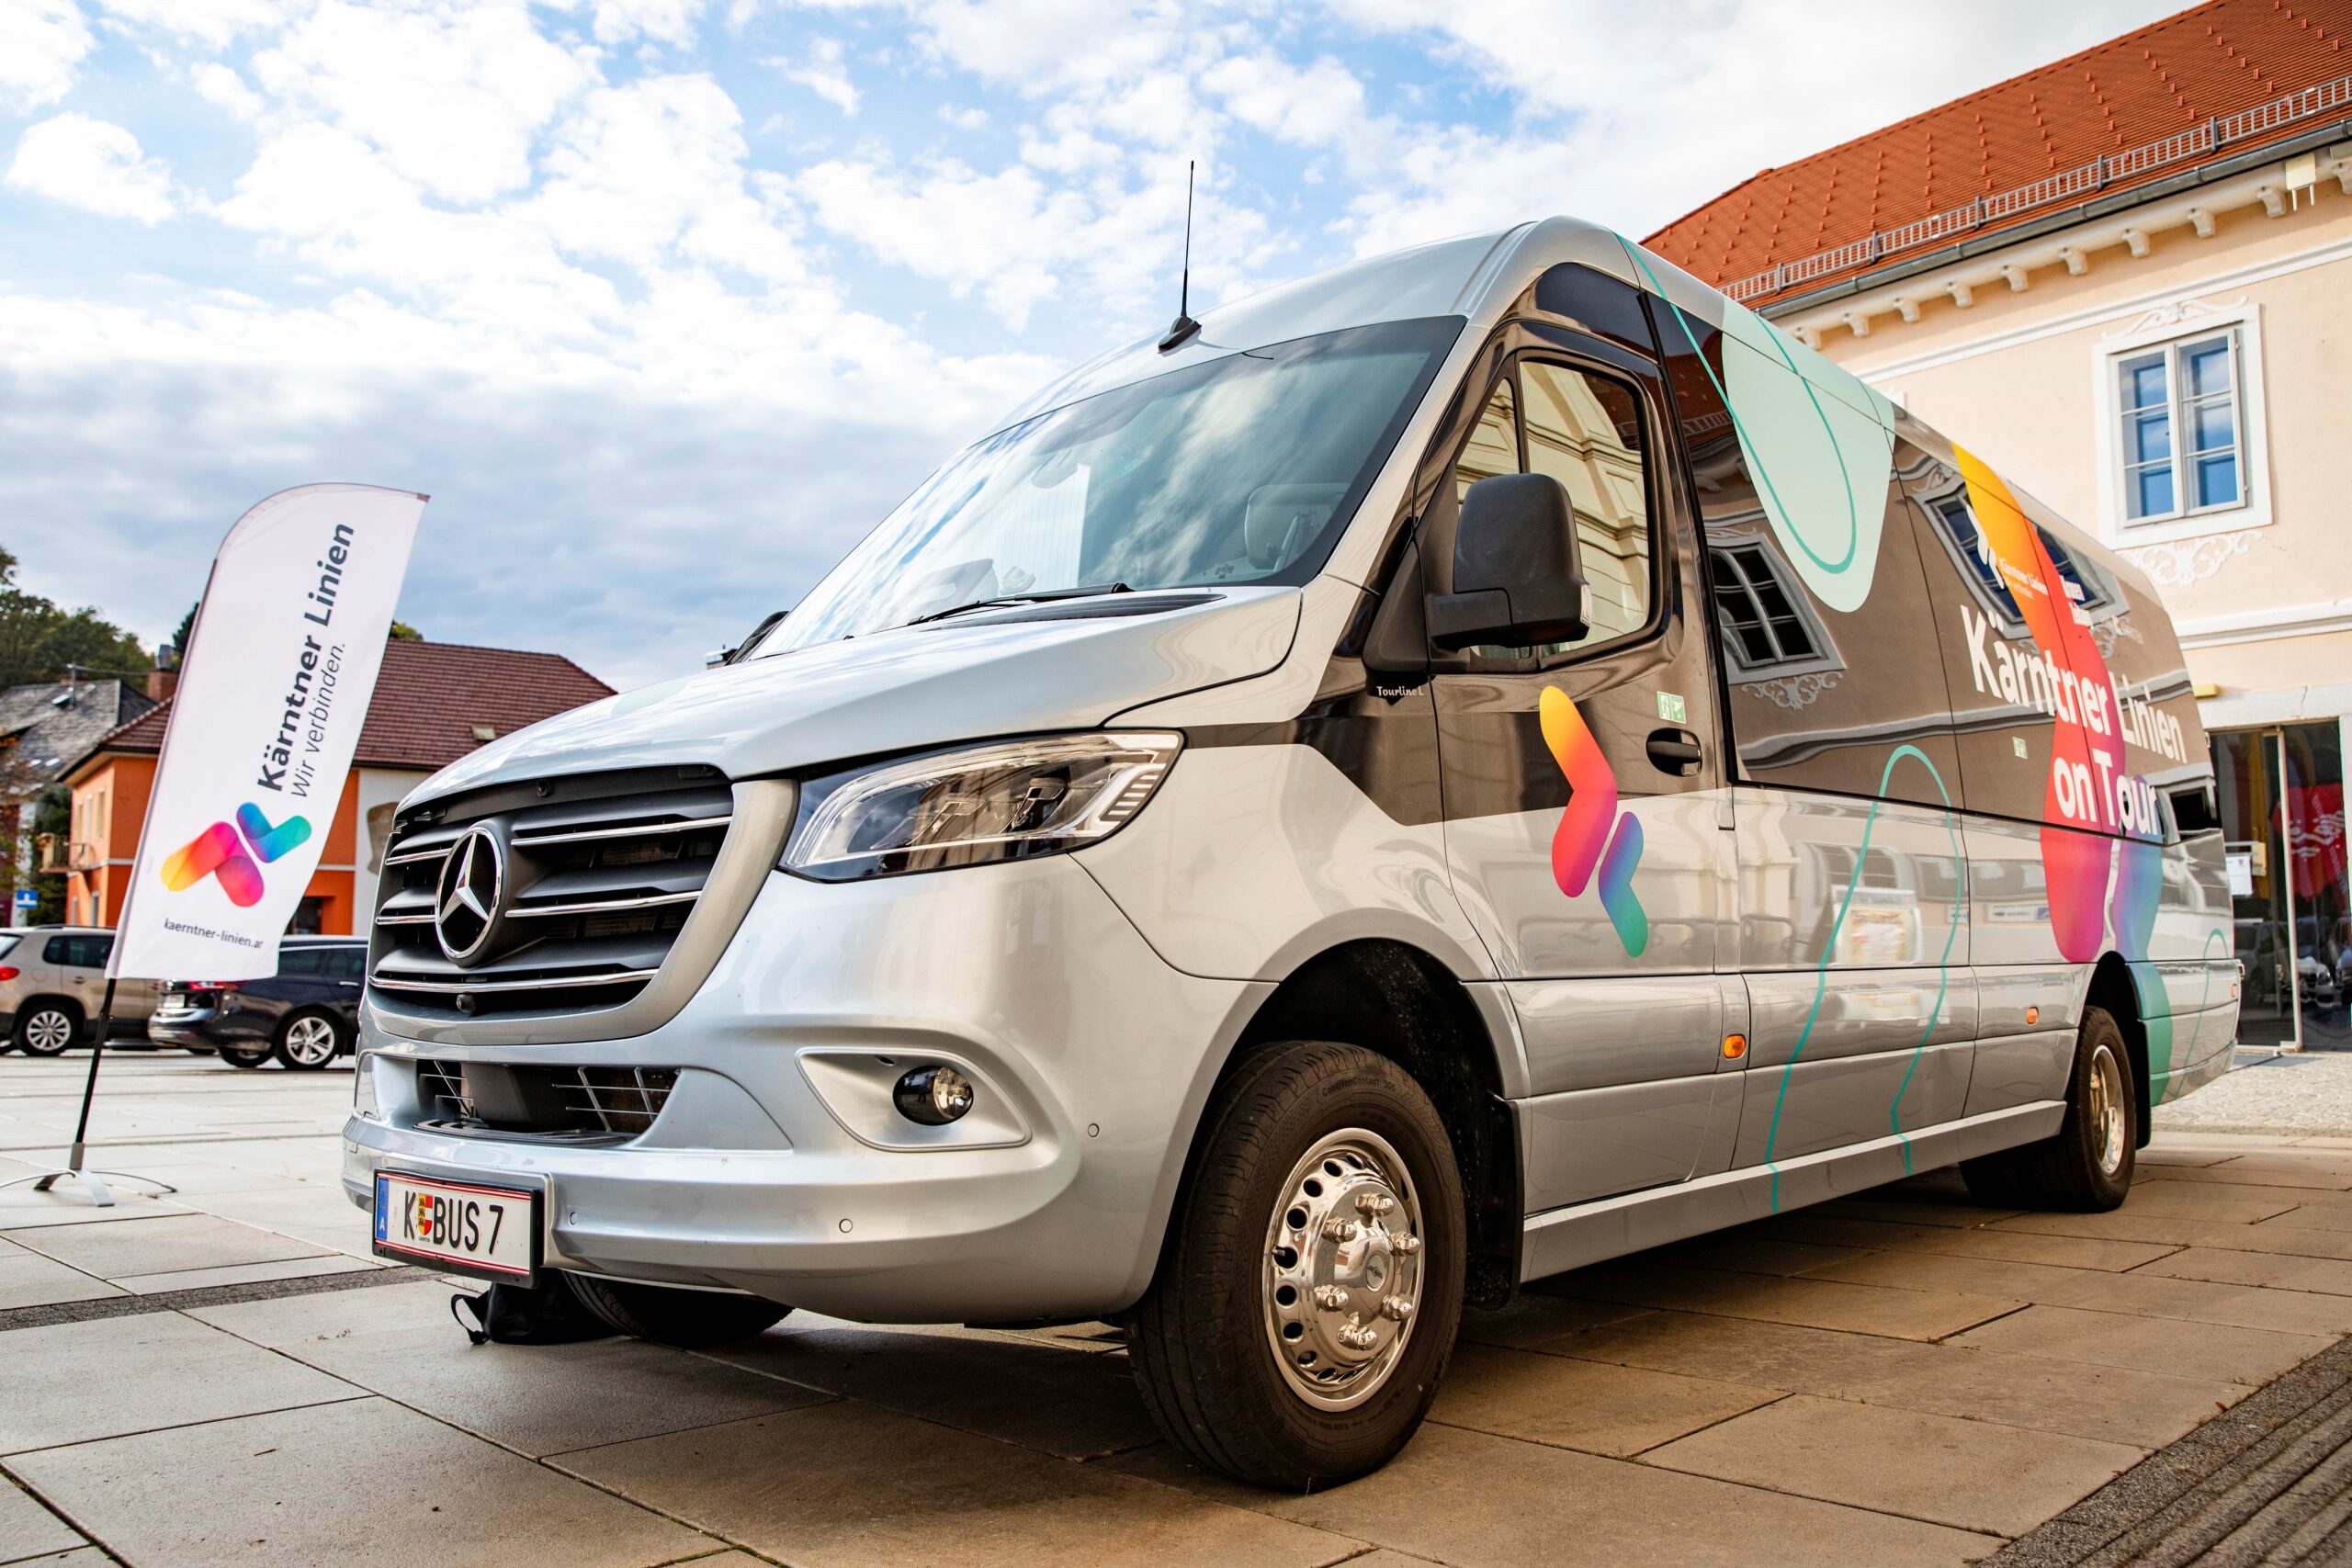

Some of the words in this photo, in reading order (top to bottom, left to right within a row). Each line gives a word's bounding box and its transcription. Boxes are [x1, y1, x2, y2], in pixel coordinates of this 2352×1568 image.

[257, 635, 322, 792] Kärntner
[304, 523, 355, 627] Linien
[1376, 685, 1417, 696] Tourline
[1961, 604, 2111, 736] Kärntner
[2109, 671, 2188, 763] Linien
[291, 760, 315, 796] Wir
[305, 643, 345, 752] verbinden.
[2053, 756, 2097, 822] on
[2092, 749, 2158, 836] Tour
[379, 1216, 386, 1232] A
[404, 1190, 416, 1240] K
[434, 1196, 480, 1252] BUS
[489, 1204, 504, 1256] 7
